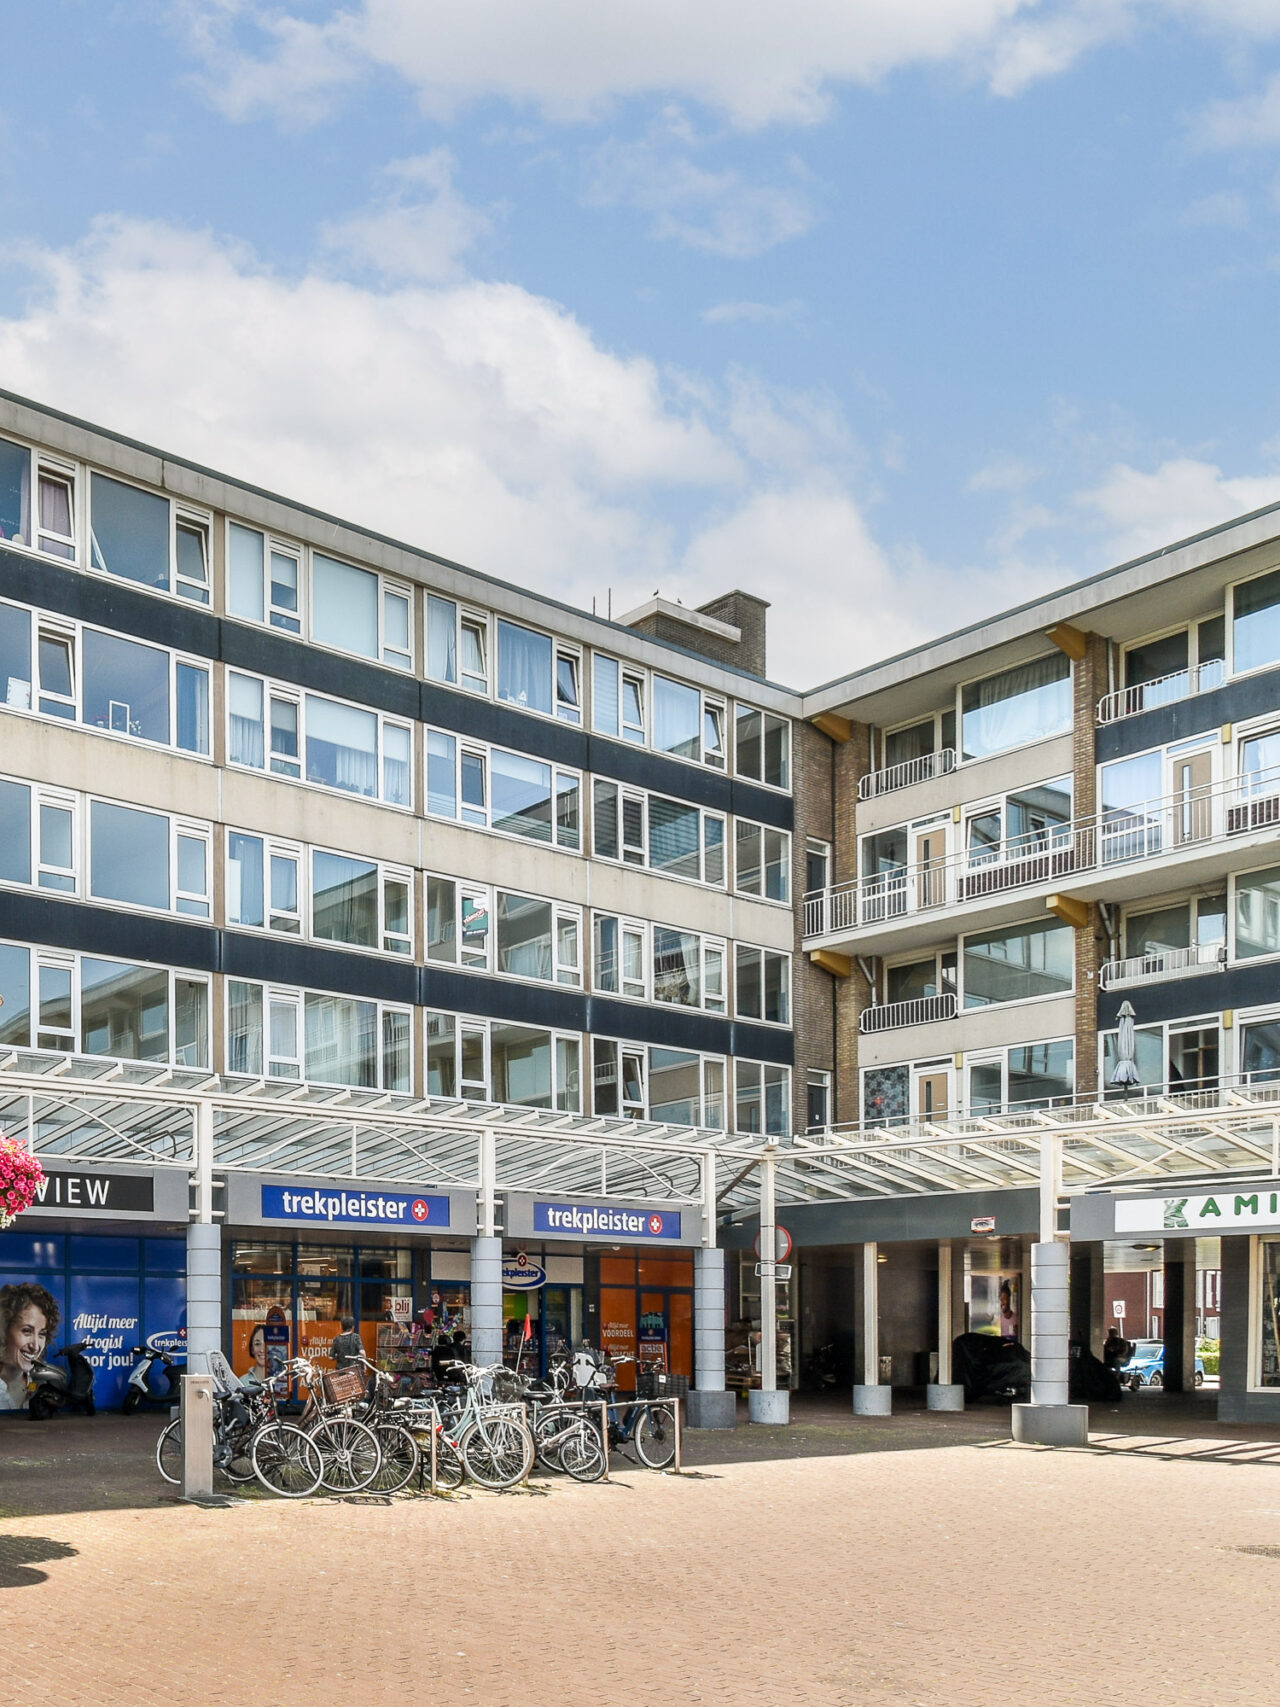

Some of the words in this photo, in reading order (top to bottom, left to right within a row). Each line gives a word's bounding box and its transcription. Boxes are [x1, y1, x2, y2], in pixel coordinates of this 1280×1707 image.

[34, 1176, 110, 1206] VIEW
[282, 1190, 407, 1221] trekpleister
[547, 1207, 646, 1234] trekpleister
[502, 1267, 539, 1279] ekpleister
[73, 1313, 108, 1333] Altijd
[108, 1317, 138, 1329] meer
[602, 1329, 634, 1338] VOORDEEL
[84, 1354, 106, 1367] oor
[107, 1352, 134, 1370] jou!
